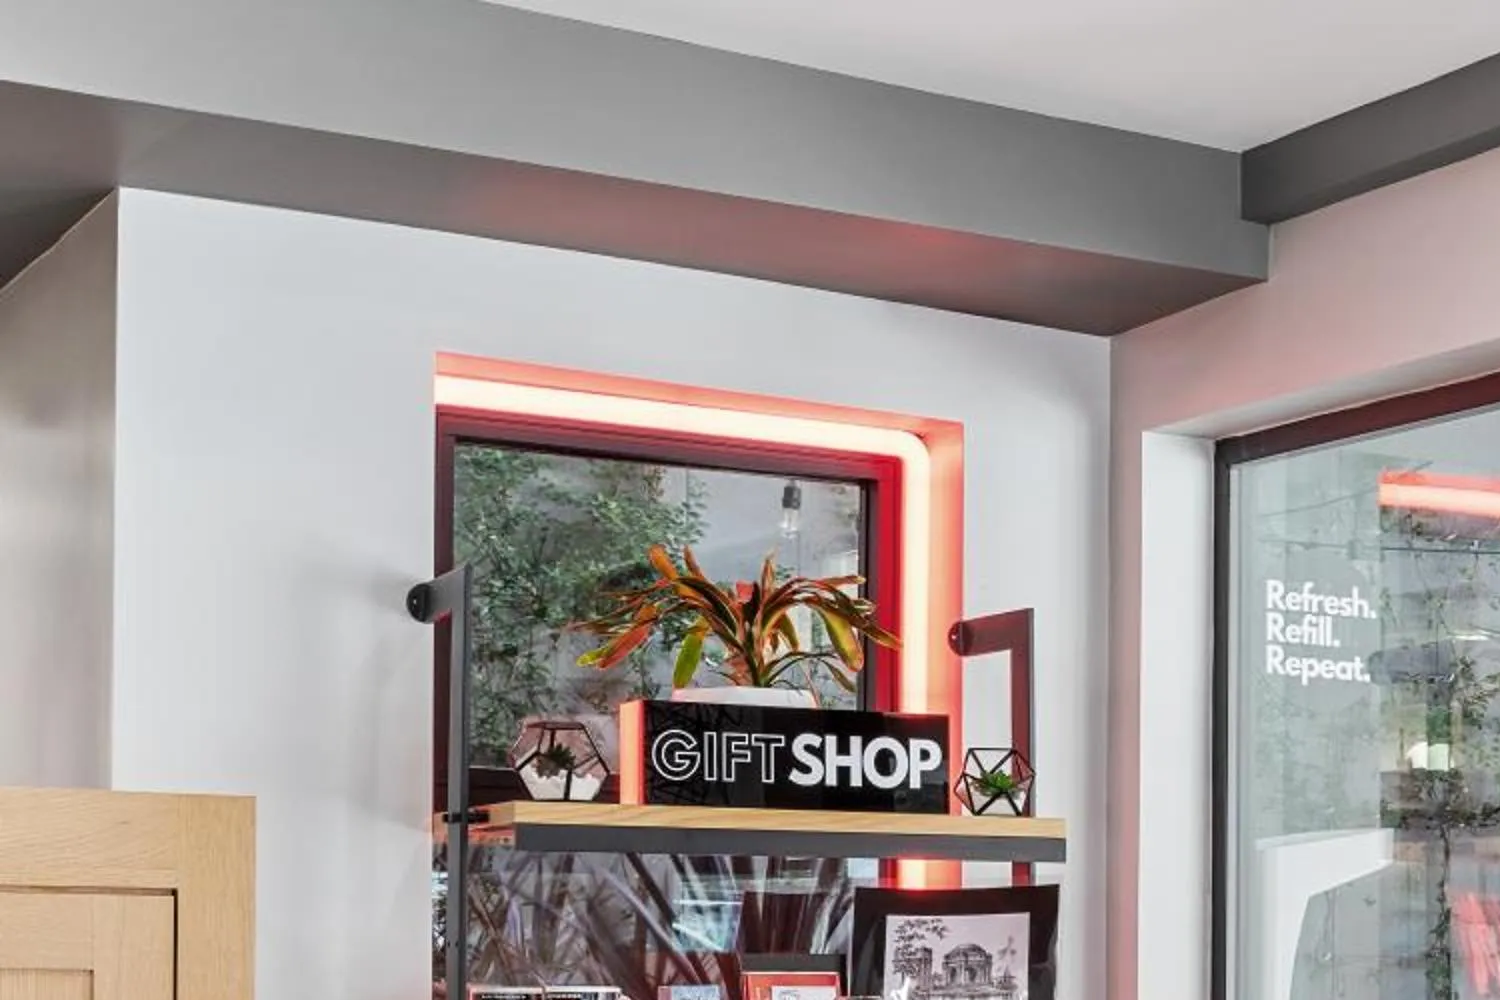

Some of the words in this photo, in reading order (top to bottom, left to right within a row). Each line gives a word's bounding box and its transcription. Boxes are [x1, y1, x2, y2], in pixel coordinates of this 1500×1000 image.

[1266, 579, 1377, 619] Refresh.
[1266, 611, 1340, 647] Refill.
[1266, 644, 1371, 686] Repeat.
[651, 729, 786, 782] GIFT
[788, 733, 943, 789] SHOP
